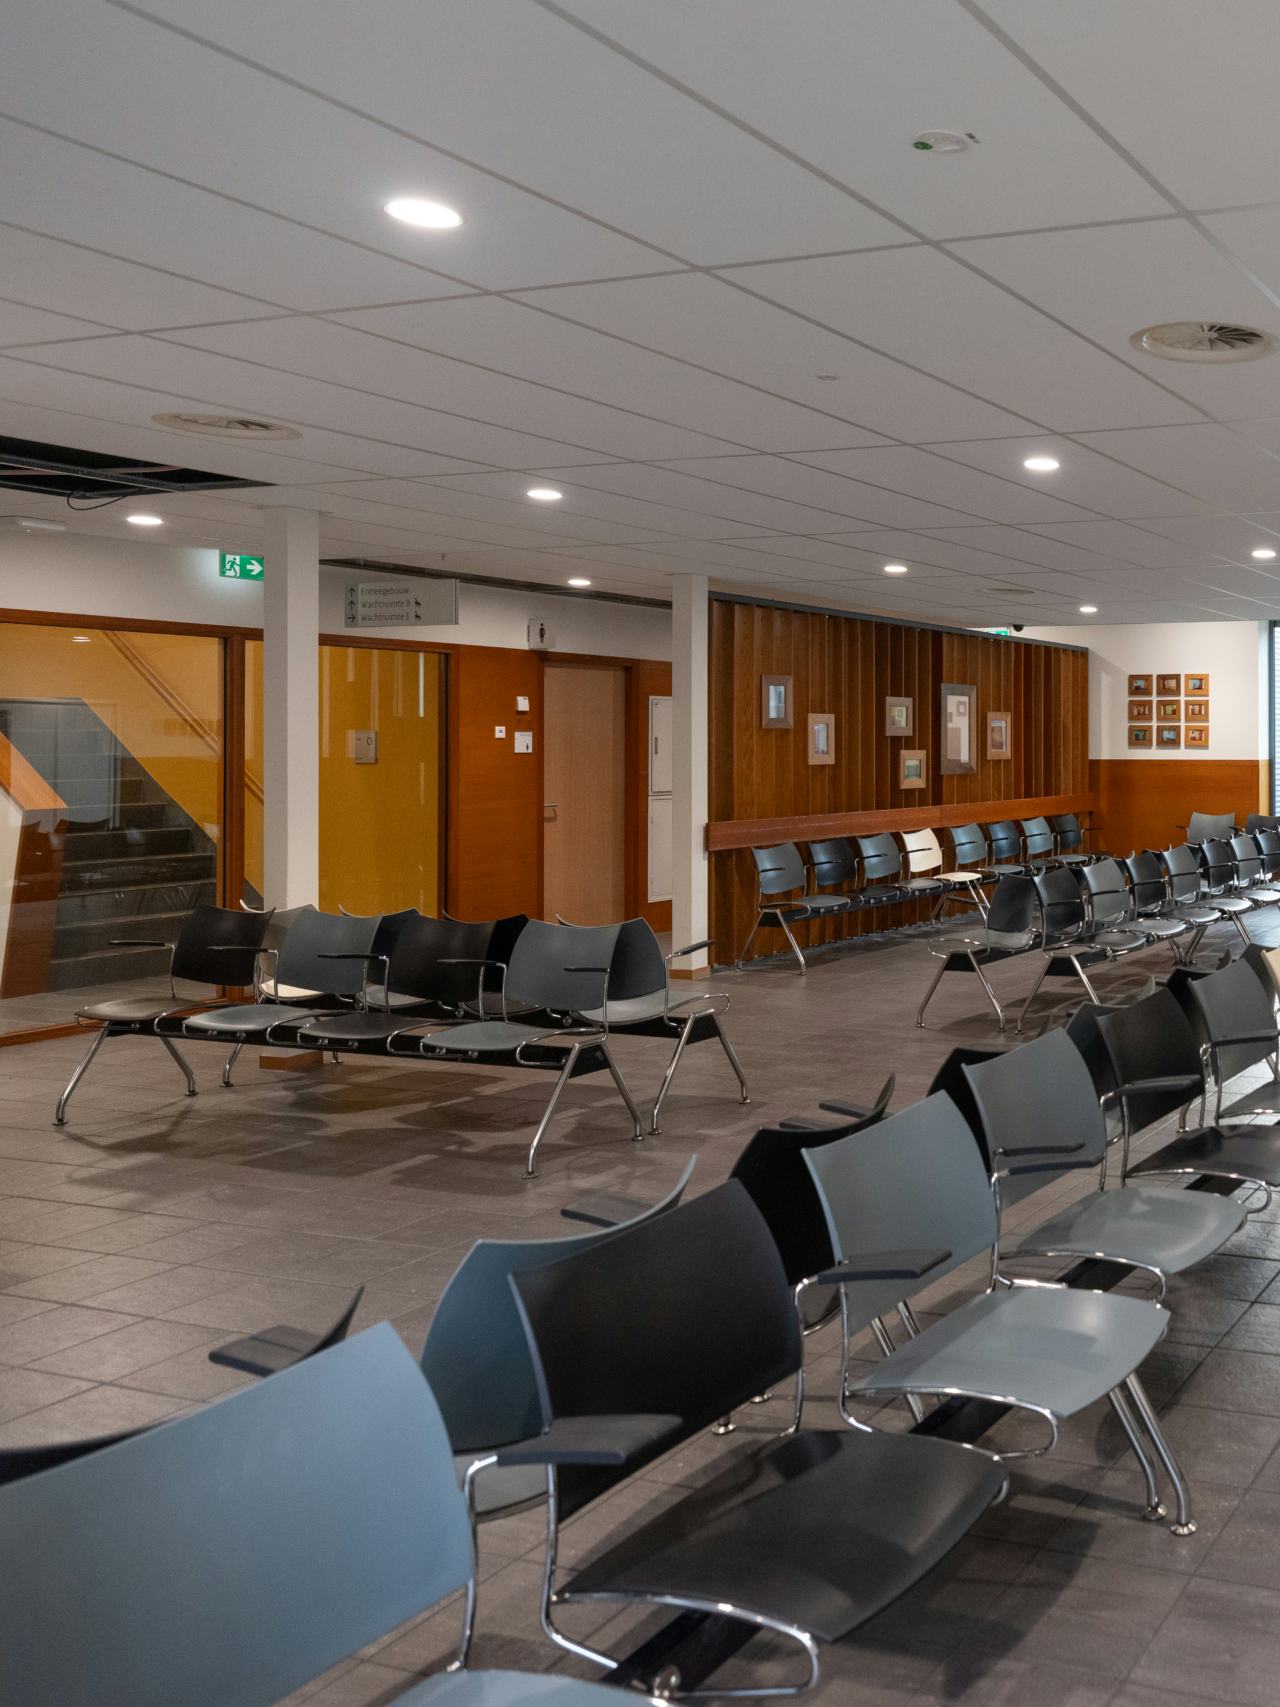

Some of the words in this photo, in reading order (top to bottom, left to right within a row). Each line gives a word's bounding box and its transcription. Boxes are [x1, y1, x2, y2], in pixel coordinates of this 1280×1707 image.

[360, 587, 410, 597] Entreegebouw
[360, 600, 405, 609] Wachtruimte
[360, 613, 405, 622] Wachtruimte
